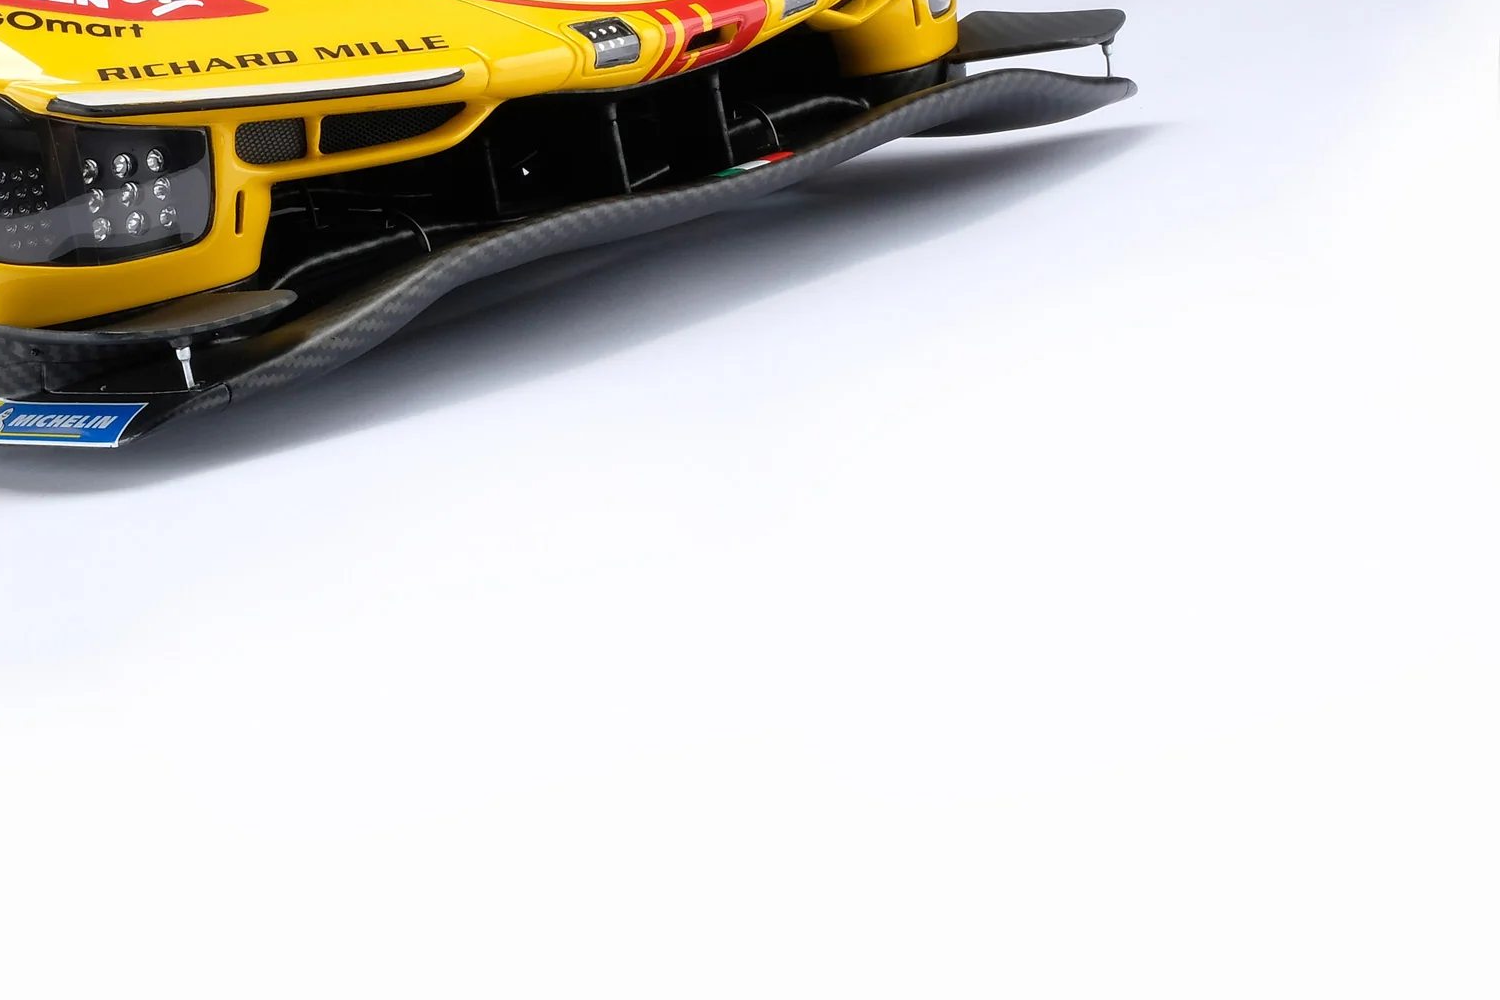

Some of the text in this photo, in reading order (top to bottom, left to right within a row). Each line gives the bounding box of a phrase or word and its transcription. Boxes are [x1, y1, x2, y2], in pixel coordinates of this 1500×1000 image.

[97, 35, 450, 81] RICHARD MILLE
[8, 413, 119, 430] MICHELIN
